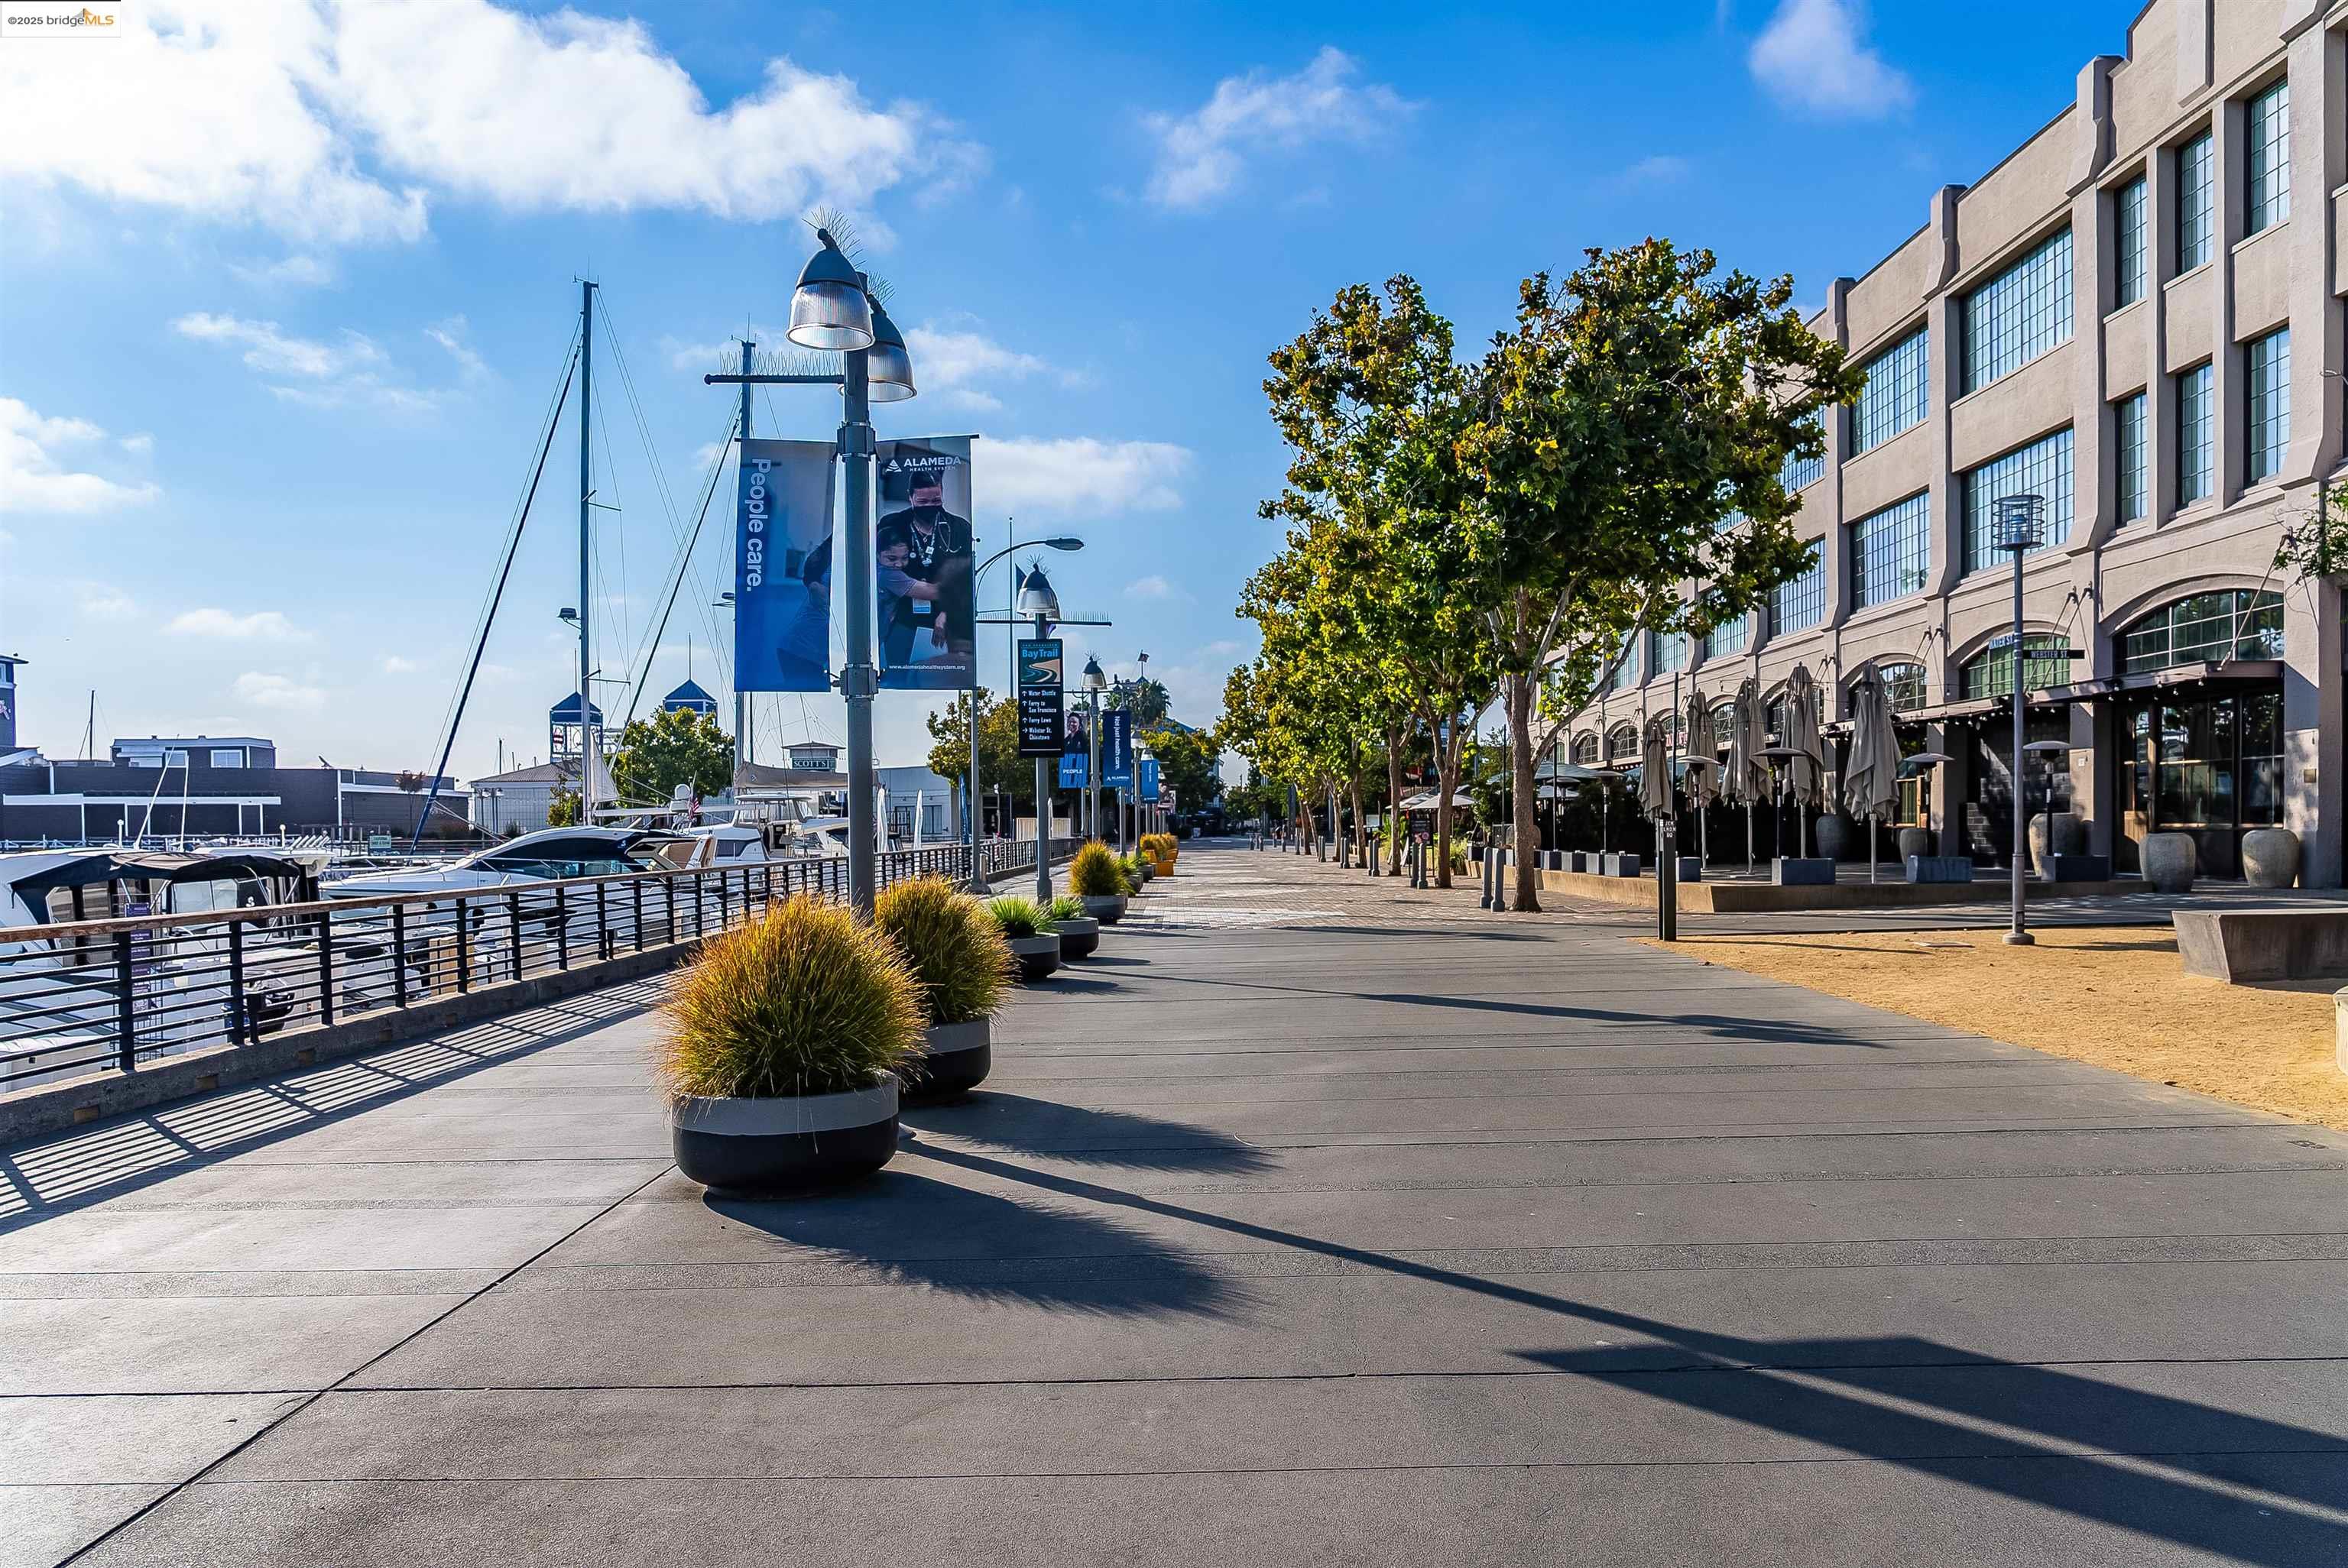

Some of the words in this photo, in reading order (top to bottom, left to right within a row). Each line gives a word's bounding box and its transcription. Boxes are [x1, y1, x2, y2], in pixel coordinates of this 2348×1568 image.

[903, 456, 962, 467] ALAMEDA
[744, 458, 771, 533] People
[746, 538, 763, 592] care.
